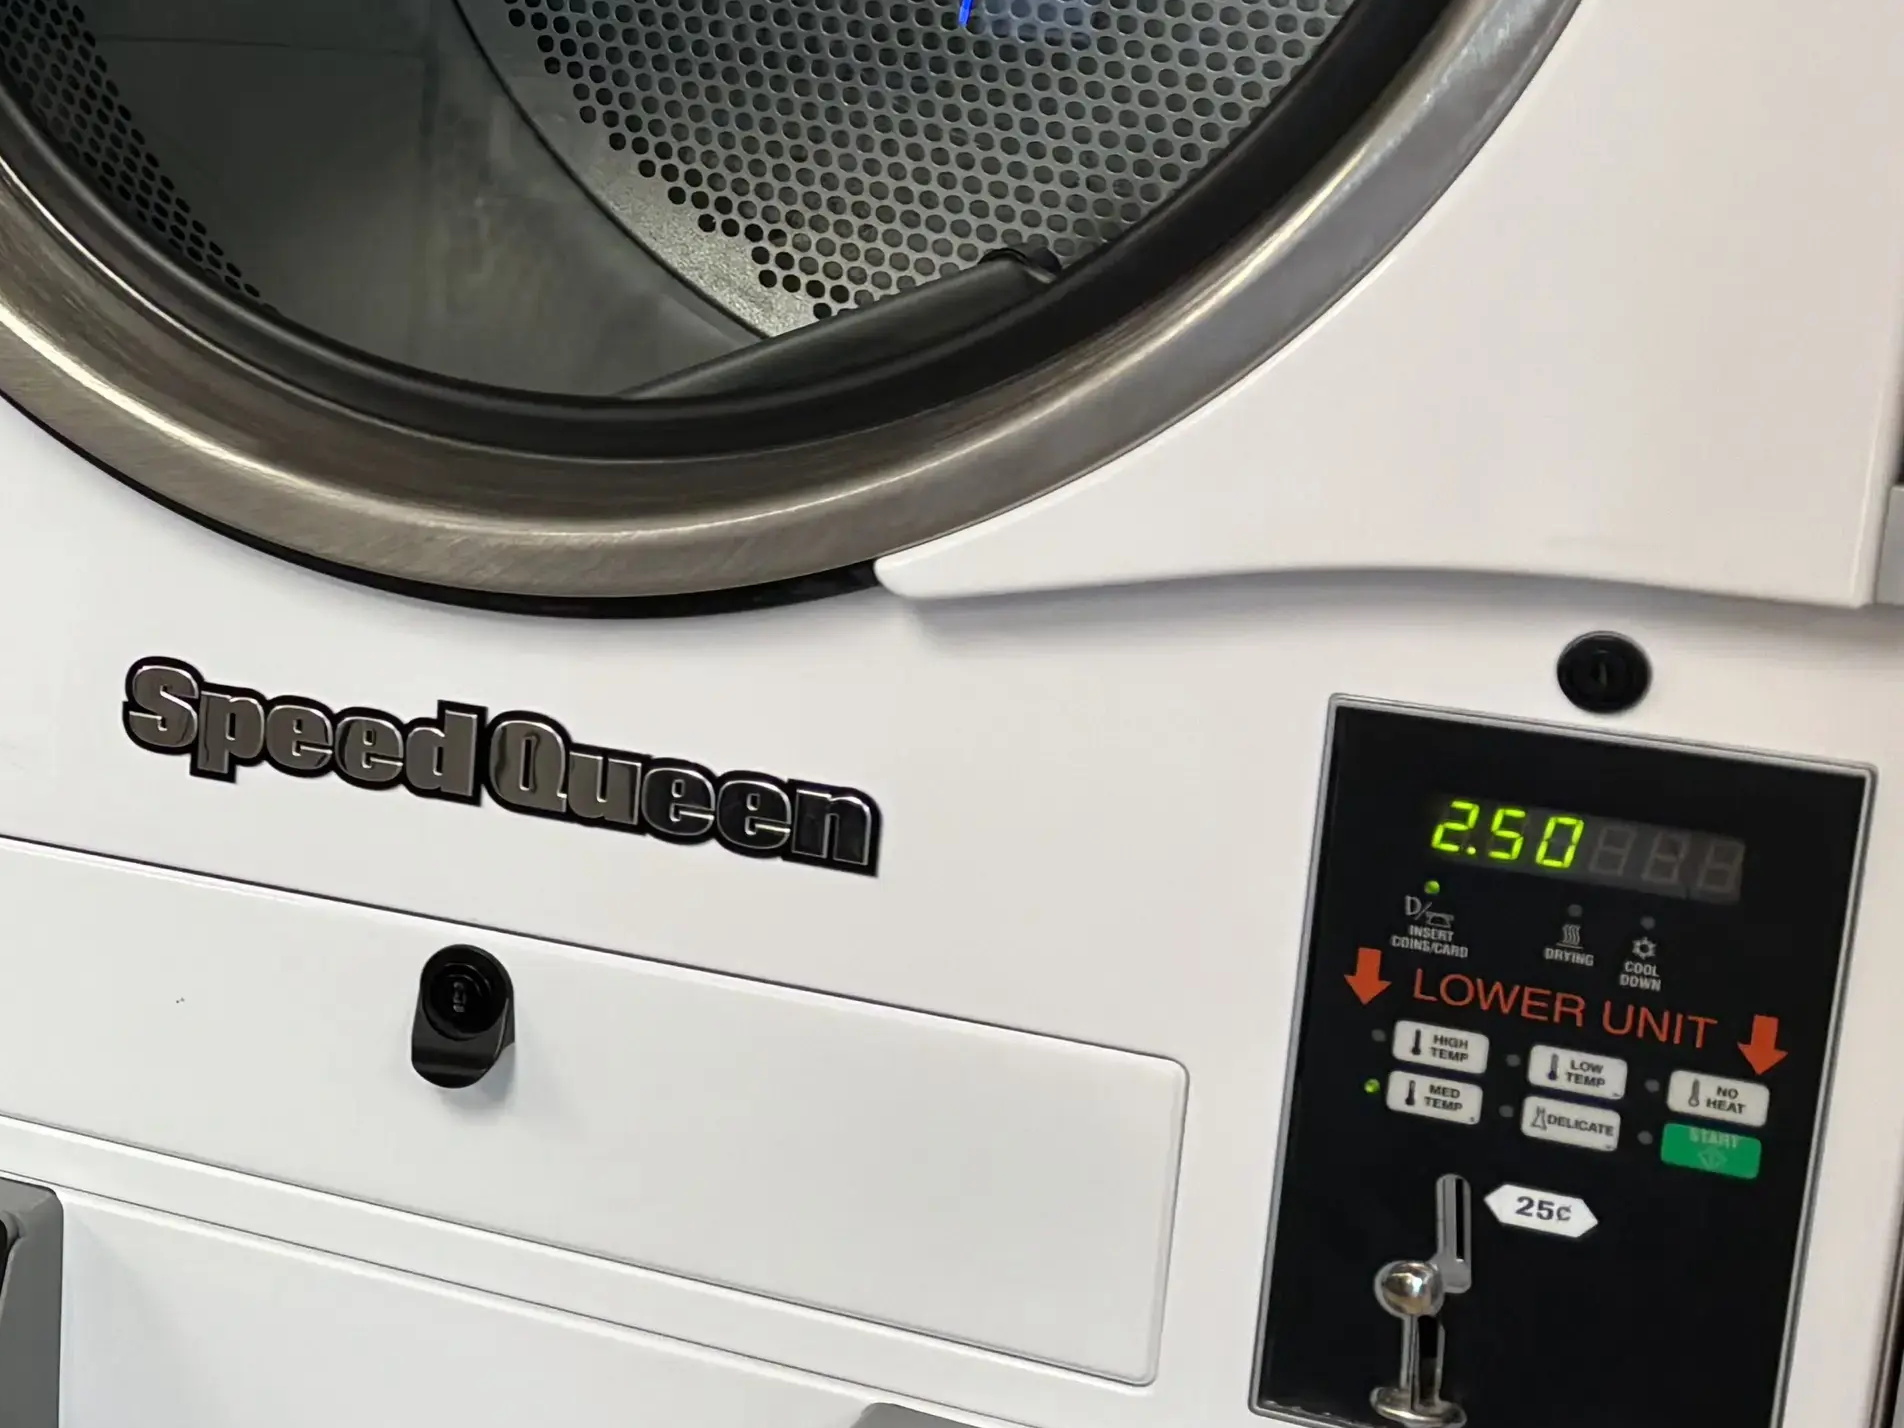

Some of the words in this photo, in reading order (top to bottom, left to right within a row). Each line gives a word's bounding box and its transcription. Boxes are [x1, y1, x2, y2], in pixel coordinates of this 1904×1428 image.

[122, 655, 488, 807] Speed
[480, 709, 884, 878] Queen
[1430, 799, 1585, 869] 2.50
[1408, 924, 1455, 943] INSERT
[1391, 934, 1469, 959] COINS/CARD
[1544, 947, 1595, 967] DRYING
[1624, 960, 1660, 979] COOL
[1619, 973, 1662, 992] DOWN
[1413, 967, 1587, 1028] LOWER
[1601, 999, 1719, 1049] UNIT
[1432, 1033, 1470, 1052] HIGH
[1429, 1045, 1470, 1064] TEMP
[1570, 1058, 1605, 1075] LOW
[1565, 1070, 1607, 1089] TEMP
[1428, 1083, 1462, 1100] MED
[1715, 1085, 1740, 1101] NO
[1423, 1096, 1464, 1114] TEMP
[1705, 1096, 1748, 1116] HEAT
[1547, 1113, 1615, 1138] DELICATE
[1688, 1126, 1743, 1150] START
[1515, 1195, 1573, 1223] 25¢
